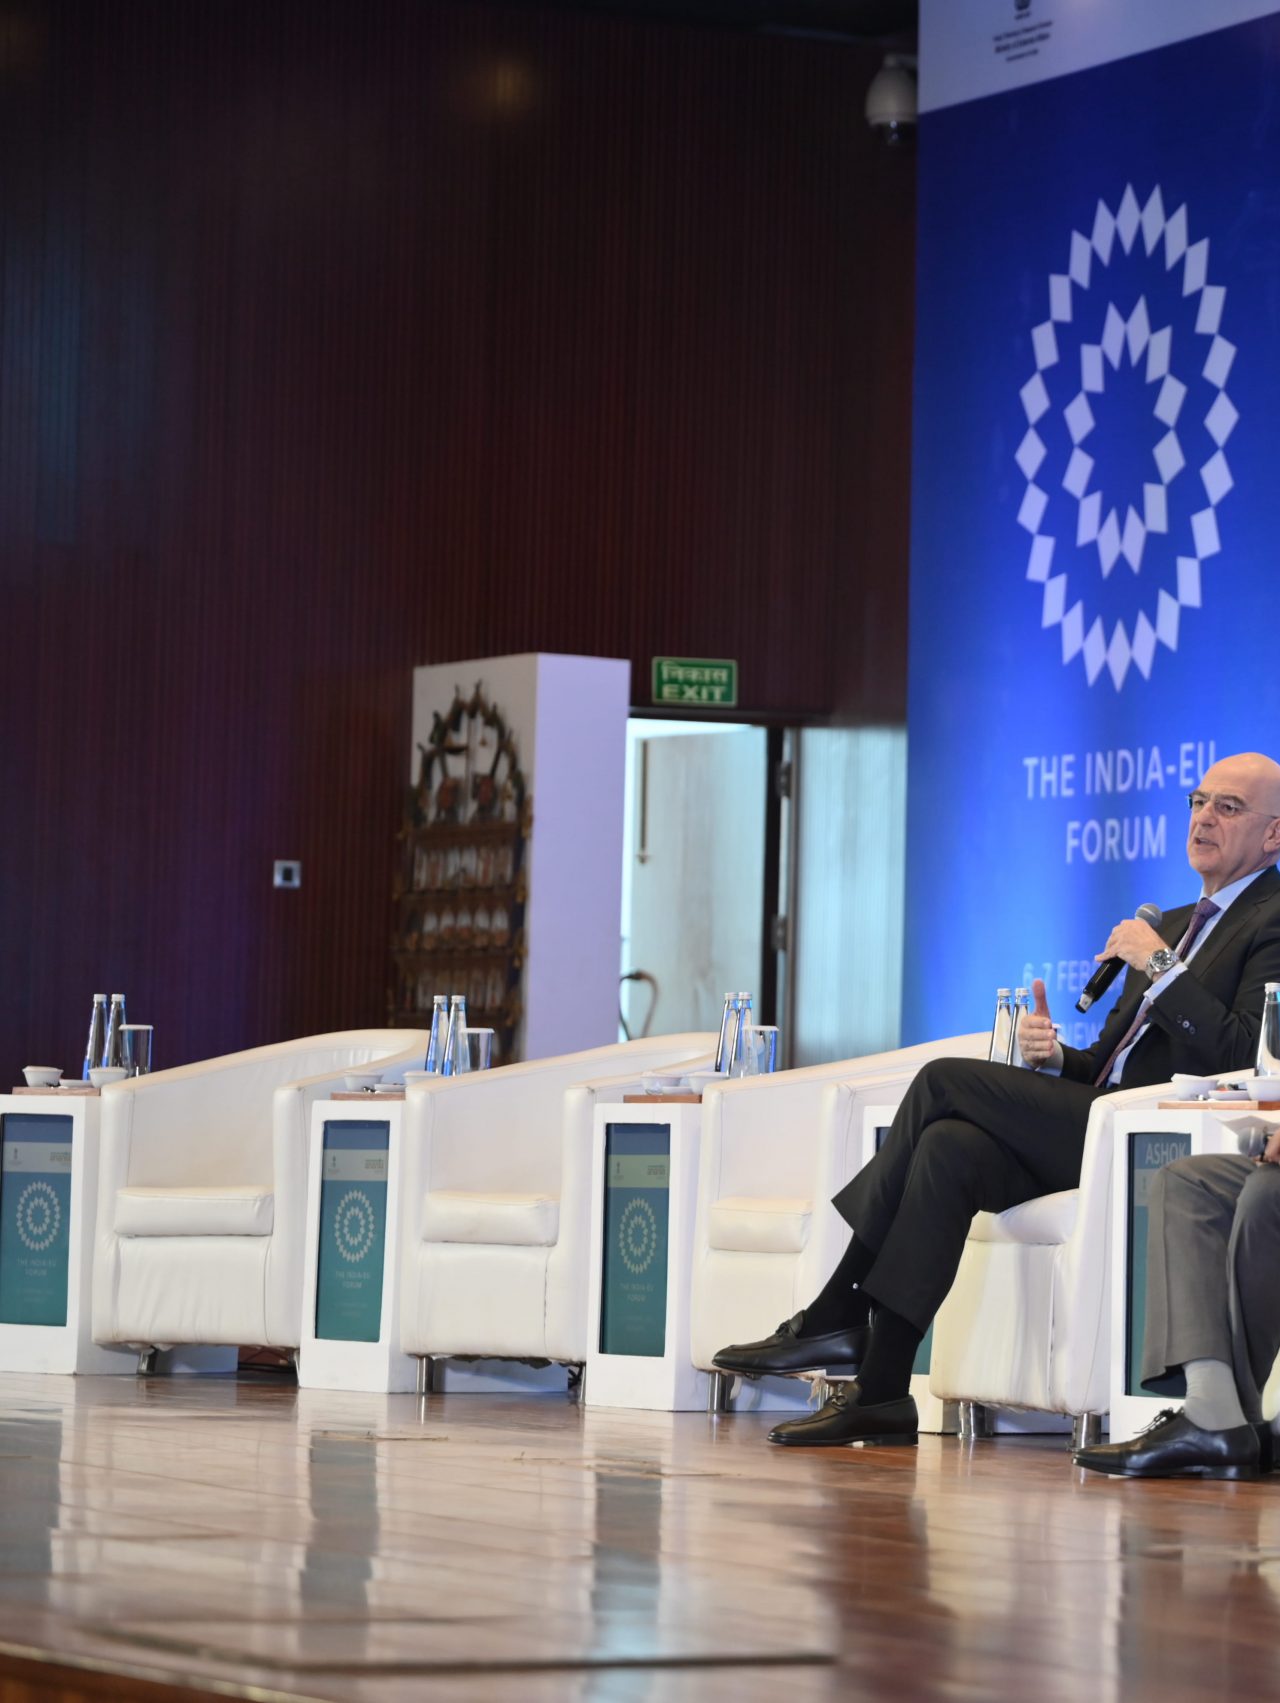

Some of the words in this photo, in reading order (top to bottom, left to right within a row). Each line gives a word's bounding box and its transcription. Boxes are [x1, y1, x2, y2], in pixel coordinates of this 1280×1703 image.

[662, 660, 728, 683] निकास
[662, 684, 727, 701] EXIT
[1023, 754, 1075, 799] THE
[1085, 740, 1216, 795] INDIA-EU
[1065, 815, 1167, 864] FORUM
[1145, 1143, 1187, 1165] ASHOK
